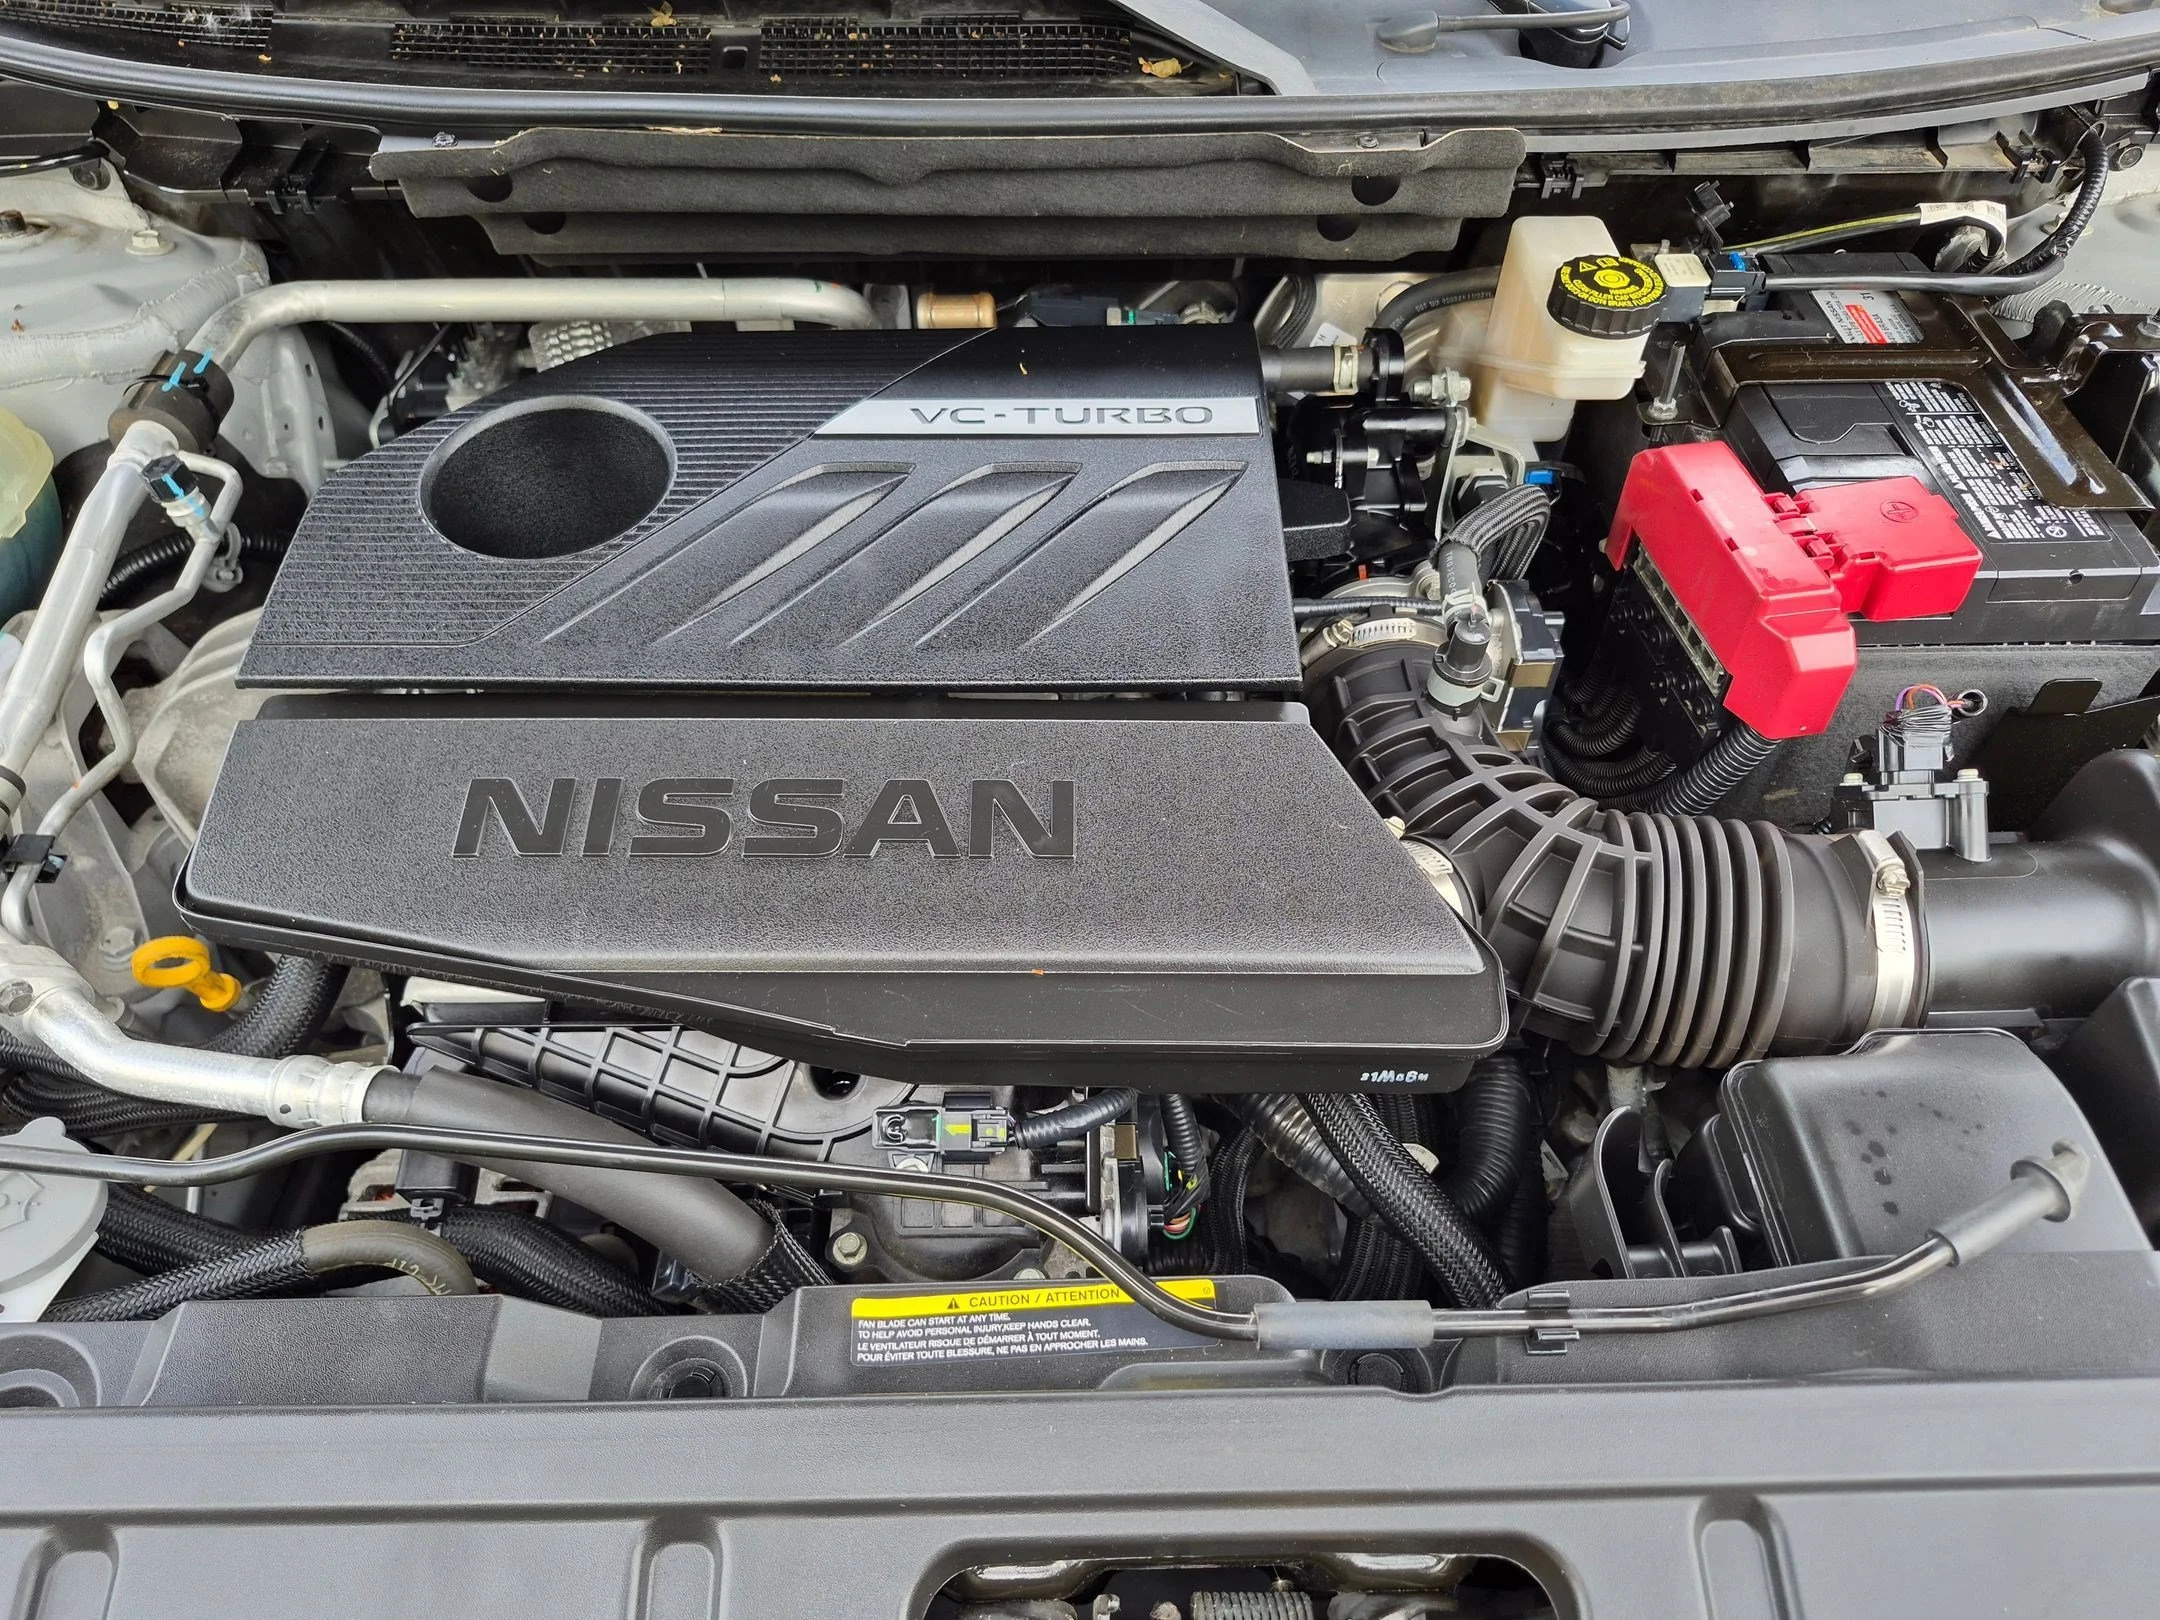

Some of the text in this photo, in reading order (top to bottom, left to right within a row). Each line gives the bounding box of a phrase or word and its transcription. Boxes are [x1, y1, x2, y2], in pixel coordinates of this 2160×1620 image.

[910, 405, 1214, 426] VC-TURBO
[453, 776, 1075, 860] NISSAN
[969, 1294, 1030, 1308] CAUTION
[1046, 1288, 1120, 1303] ATTENTION
[858, 1320, 875, 1329] FAN
[877, 1319, 906, 1329] BLADE
[907, 1318, 927, 1327] CAN
[928, 1316, 956, 1326] START
[957, 1315, 969, 1323] AT
[969, 1314, 987, 1323] ANY
[858, 1331, 870, 1340] TO
[872, 1330, 895, 1339] HELP
[896, 1328, 923, 1339] AVOID
[925, 1326, 972, 1337] PERSONAL
[1027, 1320, 1059, 1330] HANDS
[1060, 1318, 1092, 1328] CLEAR.
[857, 1337, 1149, 1362] POUR ÉVITER TOUTE BLESSURE, NE PAS EN APPROCHER LES MAINS.
[858, 1329, 1101, 1351] LE VENTILATEUR RISQUE DE DÉMARRER À TOUT MOMENT.
